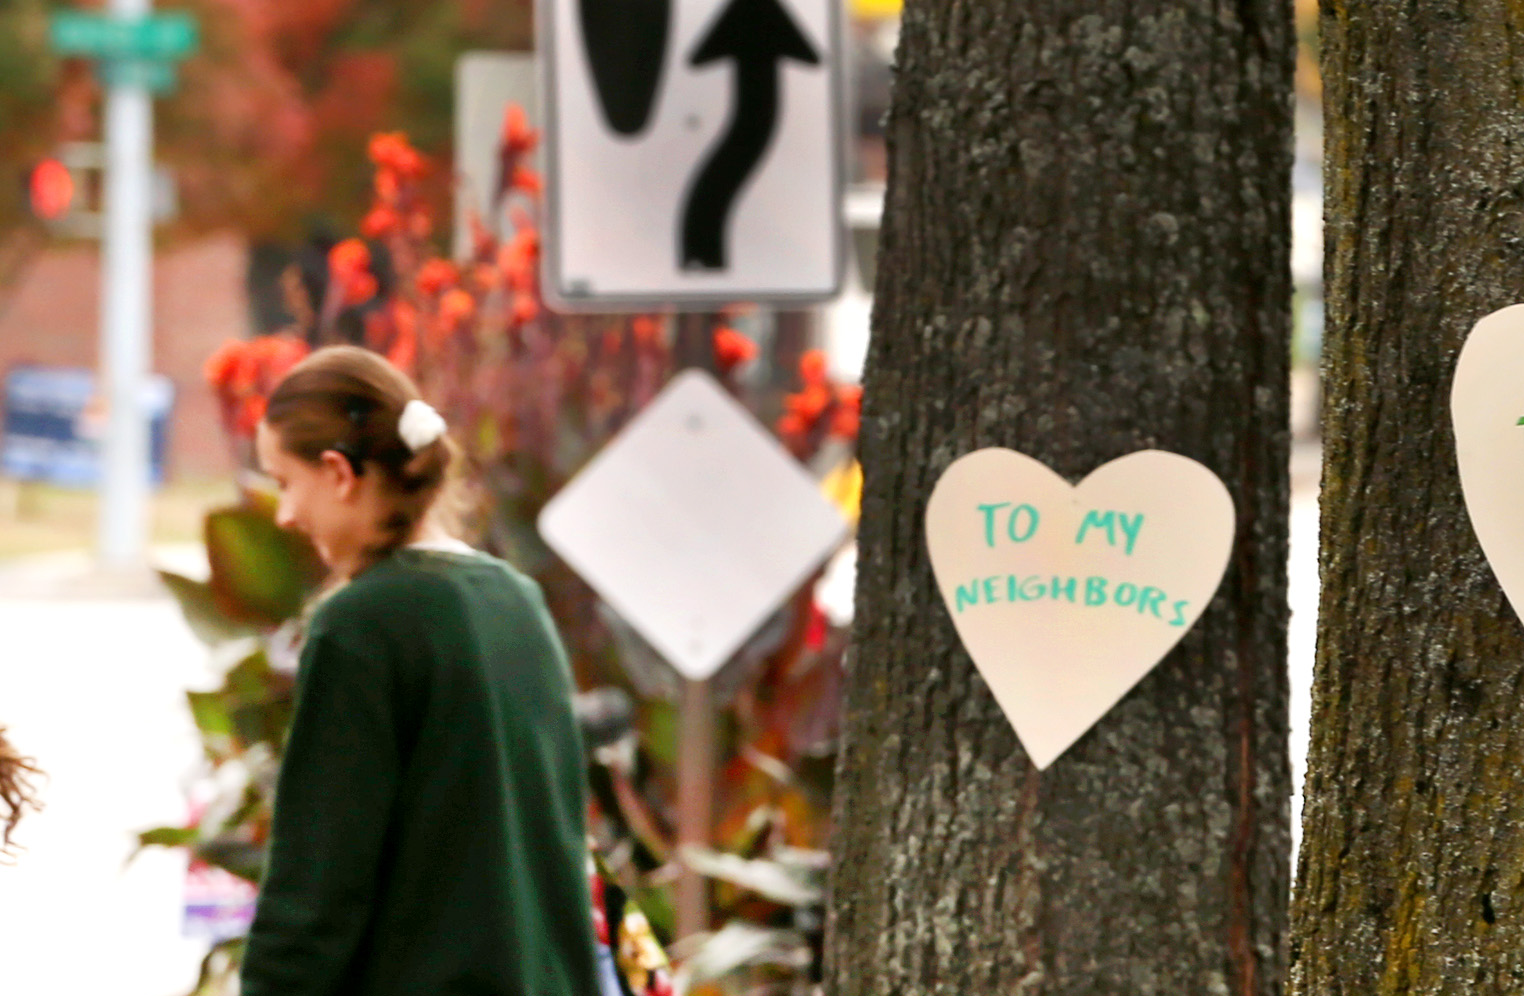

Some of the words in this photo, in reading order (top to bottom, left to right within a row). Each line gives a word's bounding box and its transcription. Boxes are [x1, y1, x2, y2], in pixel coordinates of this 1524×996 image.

[976, 502, 1040, 547] TO
[1075, 510, 1144, 555] MY
[955, 574, 1189, 627] NEIGHBORS
